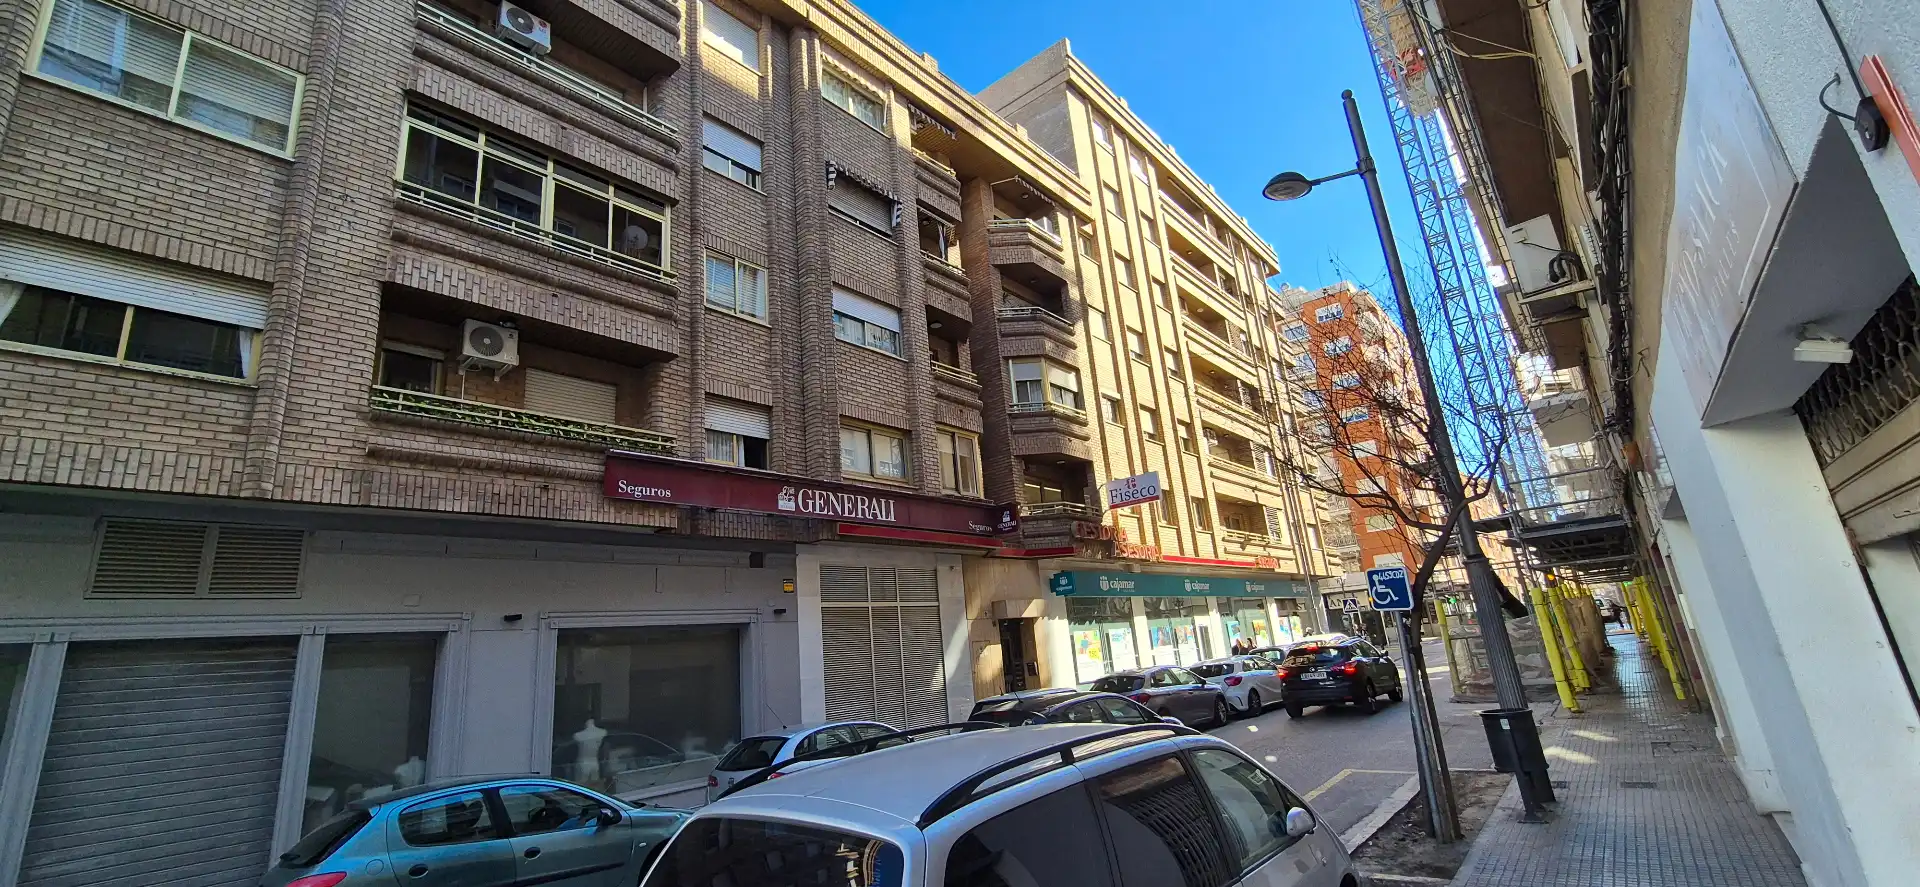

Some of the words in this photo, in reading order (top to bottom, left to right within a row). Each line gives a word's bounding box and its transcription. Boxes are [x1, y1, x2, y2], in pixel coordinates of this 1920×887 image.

[618, 479, 672, 498] Seguros
[1109, 485, 1156, 504] Fiseco
[797, 488, 897, 522] GENERALI
[968, 520, 993, 533] Seguros
[997, 520, 1017, 529] GENERALI
[1110, 577, 1135, 592] cajamar
